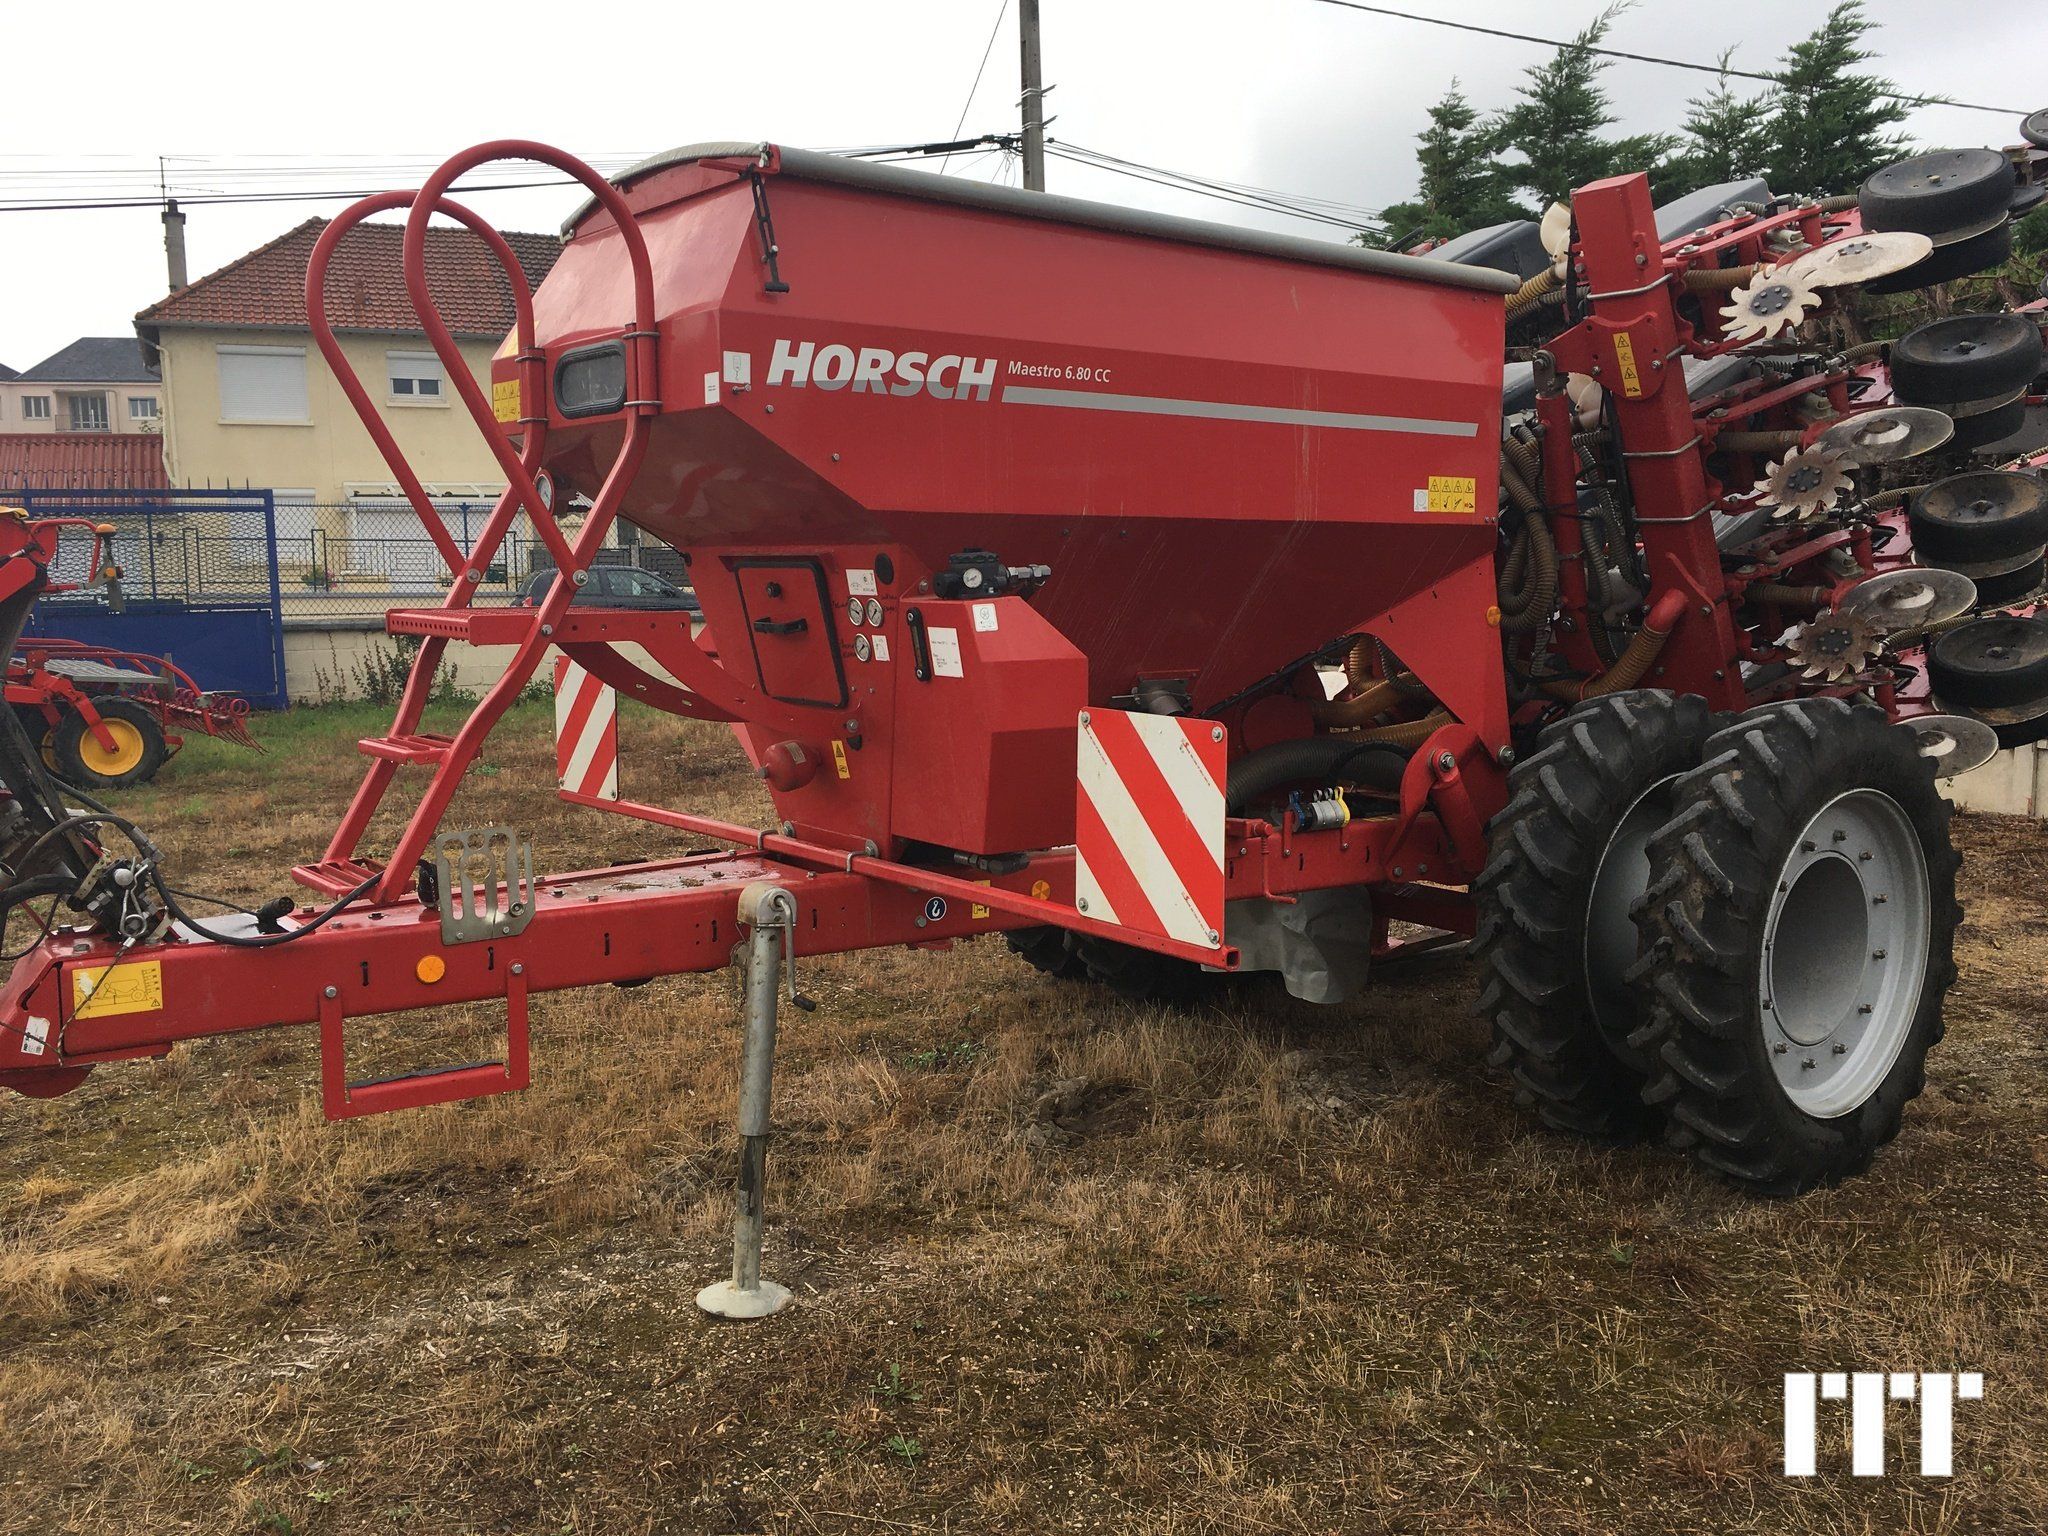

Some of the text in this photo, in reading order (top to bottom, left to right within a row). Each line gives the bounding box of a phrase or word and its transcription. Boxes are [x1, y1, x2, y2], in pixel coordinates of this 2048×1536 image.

[766, 339, 998, 402] HORSCH
[1008, 360, 1112, 383] Maestro 6.80 CC
